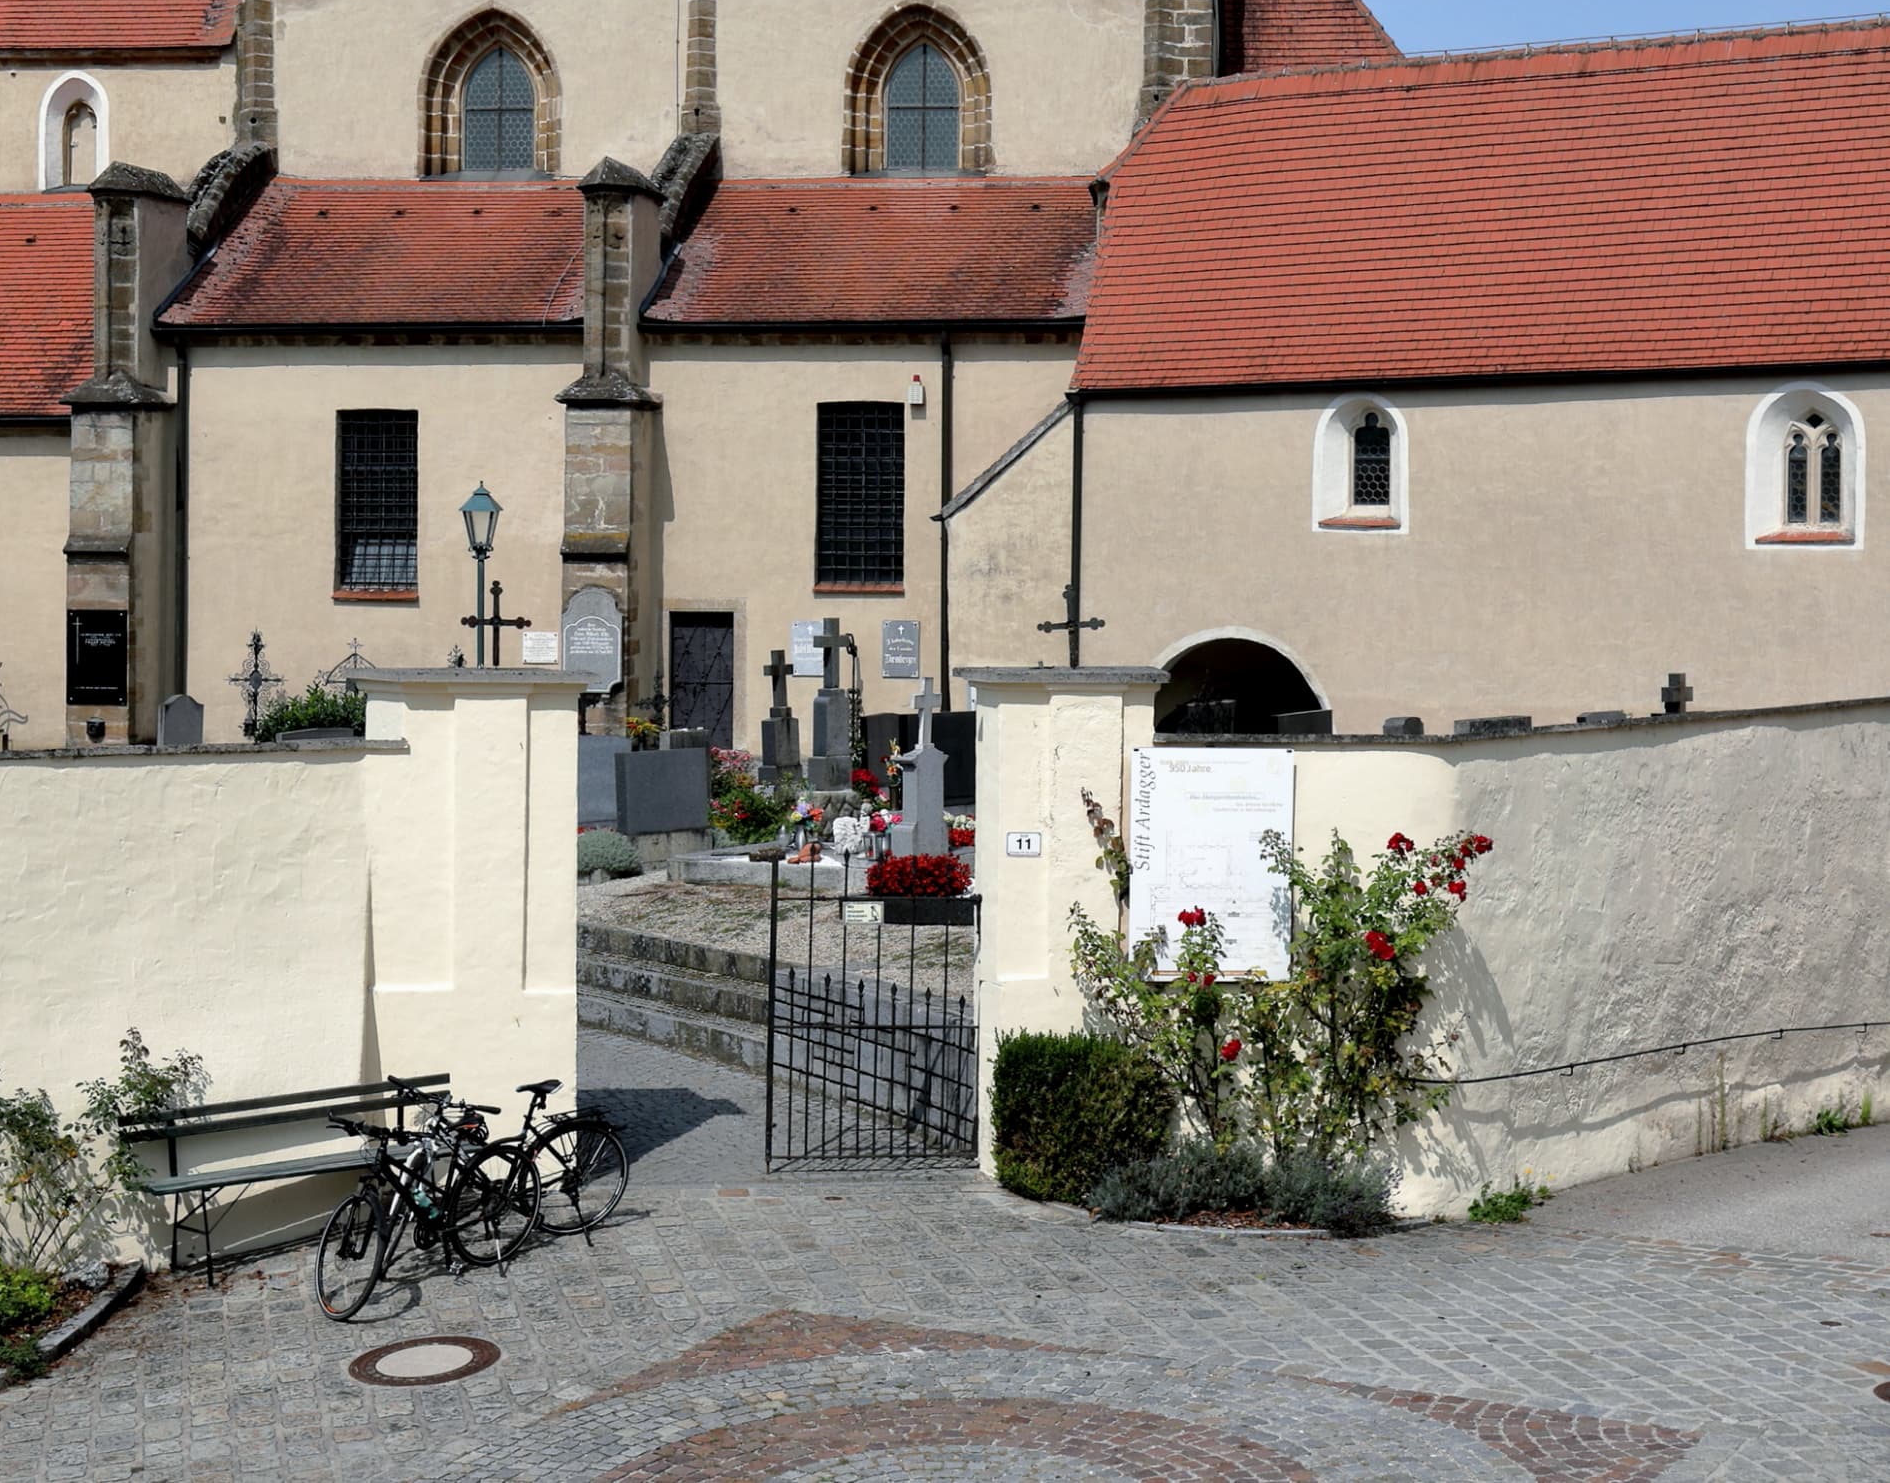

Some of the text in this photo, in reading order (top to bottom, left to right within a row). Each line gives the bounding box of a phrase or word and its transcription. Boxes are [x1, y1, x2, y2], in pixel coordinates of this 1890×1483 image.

[1016, 838, 1031, 850] 11
[1134, 752, 1156, 871] Stift Ardagger
